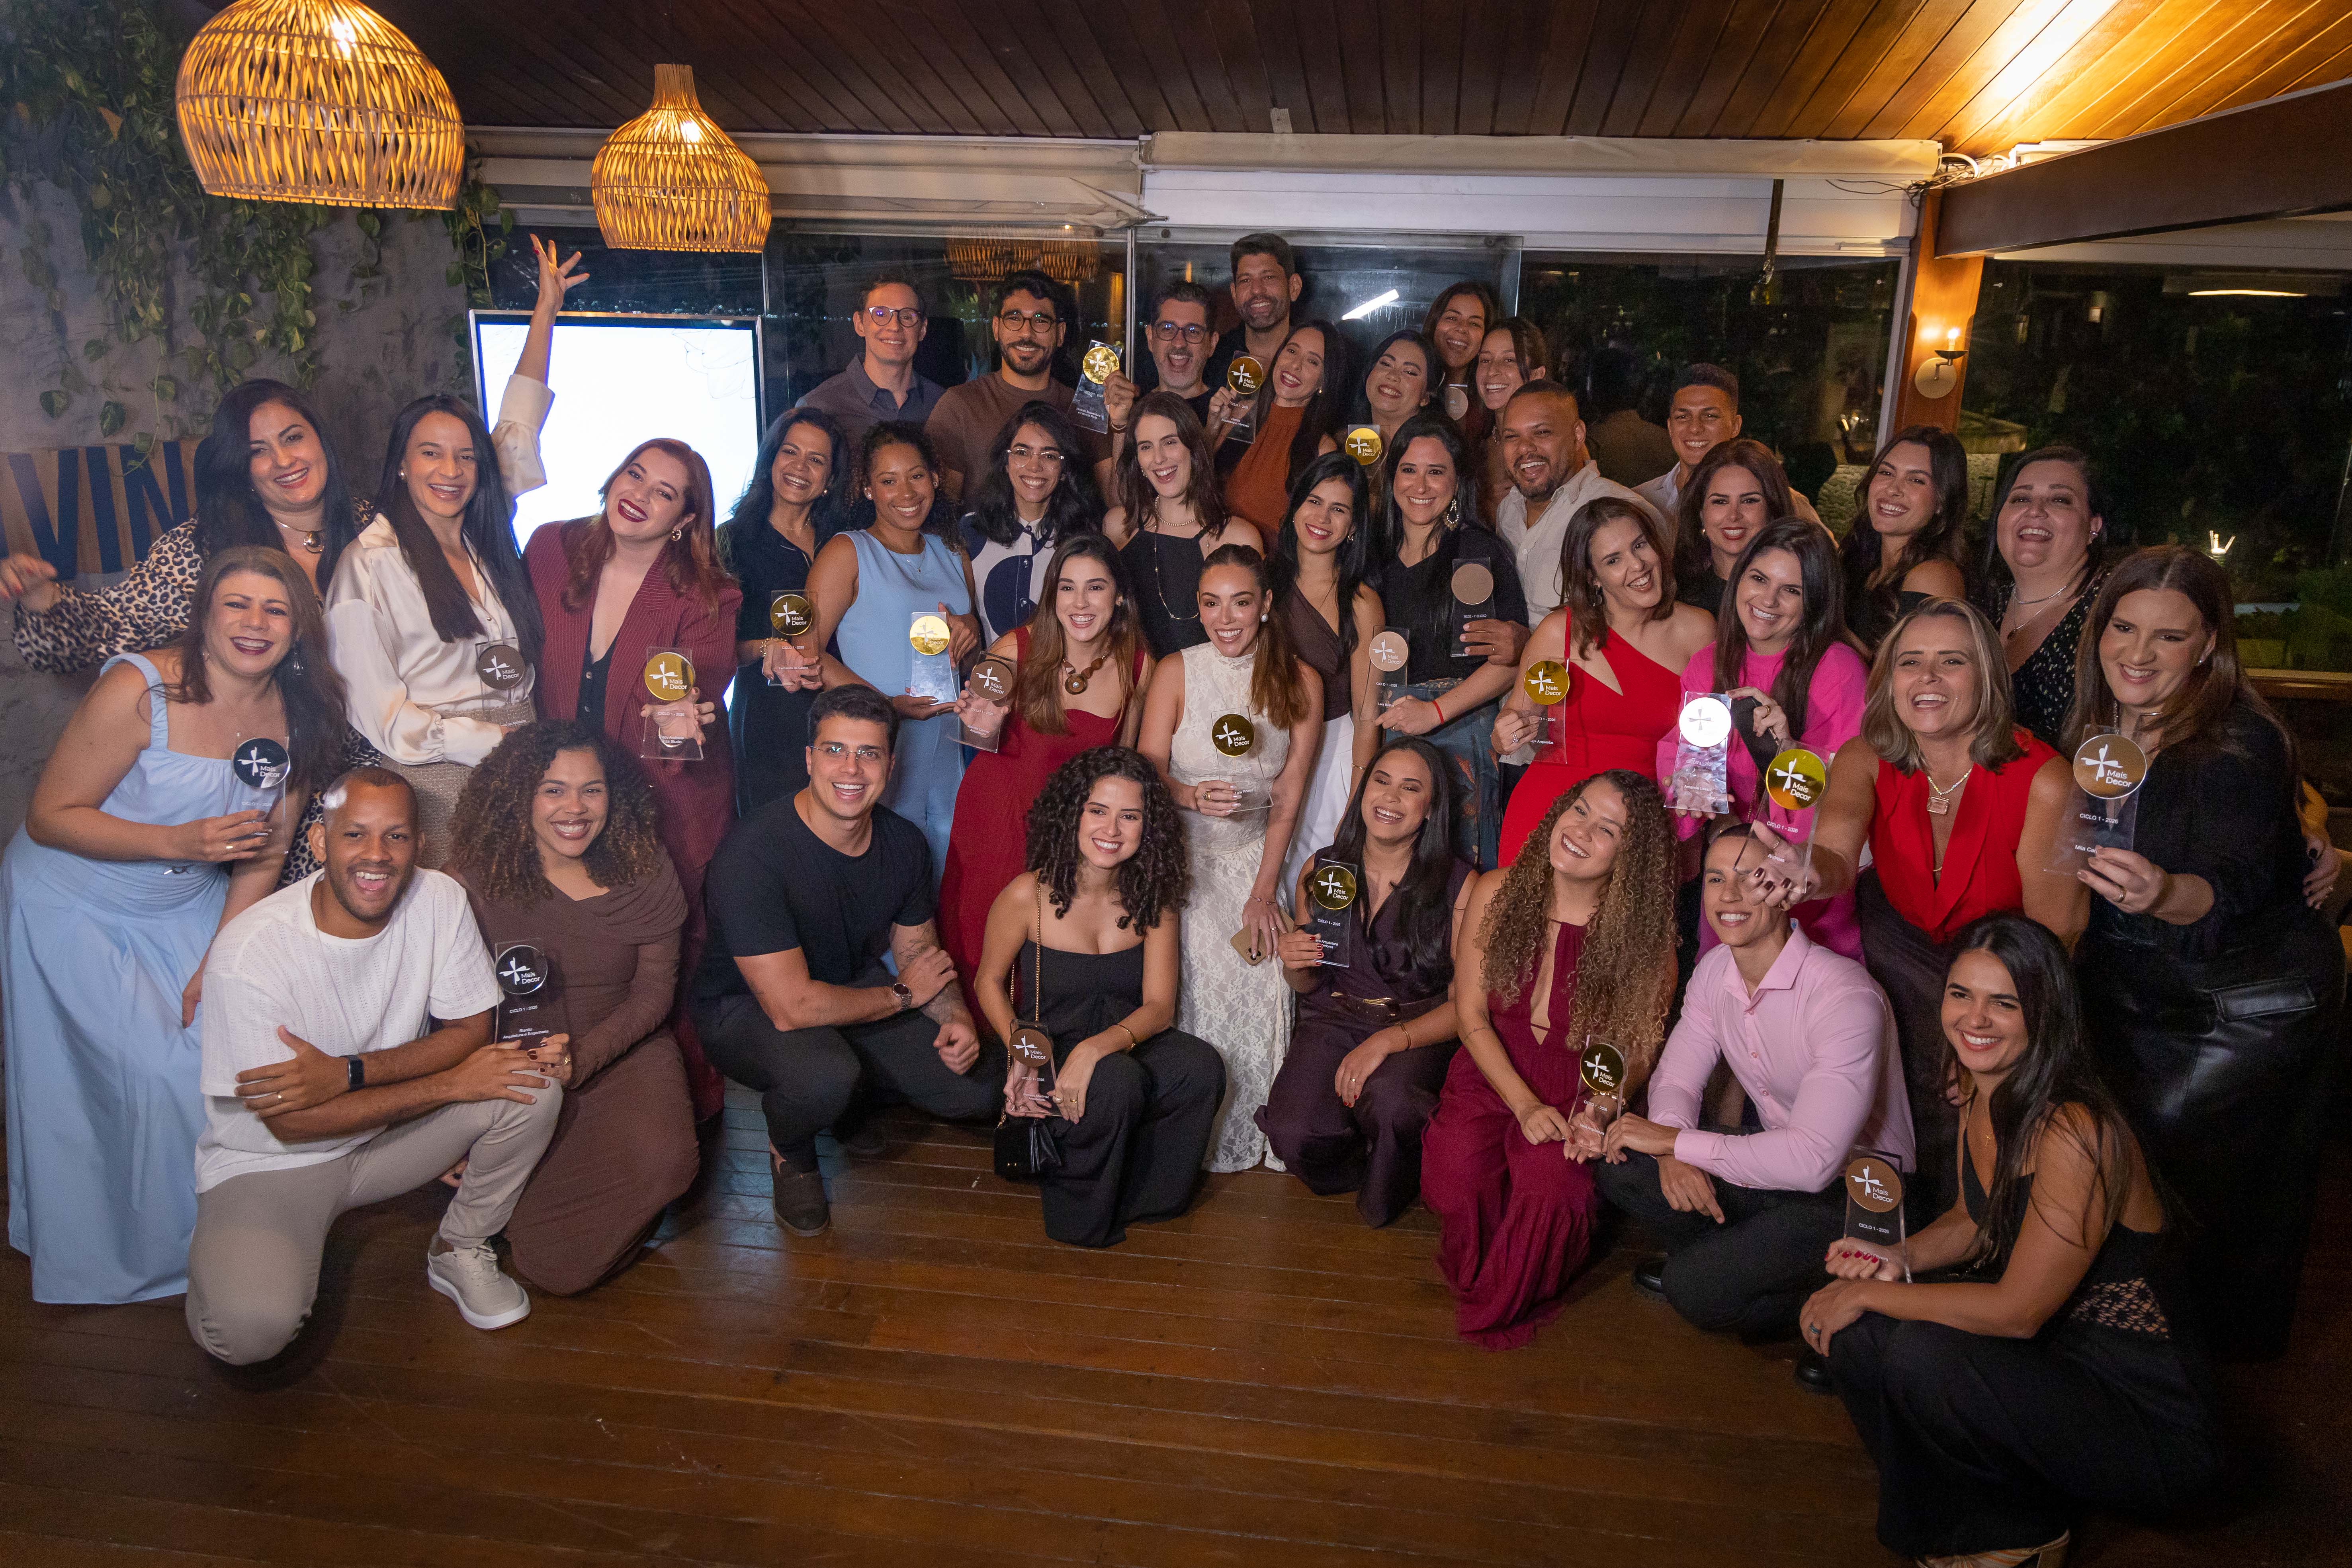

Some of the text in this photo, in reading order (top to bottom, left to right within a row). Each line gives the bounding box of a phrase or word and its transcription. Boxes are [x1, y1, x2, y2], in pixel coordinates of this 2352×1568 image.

[2107, 770, 2127, 779] Mais
[2106, 776, 2132, 787] Decor
[1793, 782, 1808, 793] Mais
[1790, 789, 1811, 801] Decor
[1600, 1072, 1612, 1081] Mais
[1599, 1077, 1615, 1087] Decor
[1873, 1187, 1889, 1196] Mais
[1873, 1193, 1893, 1203] Decor
